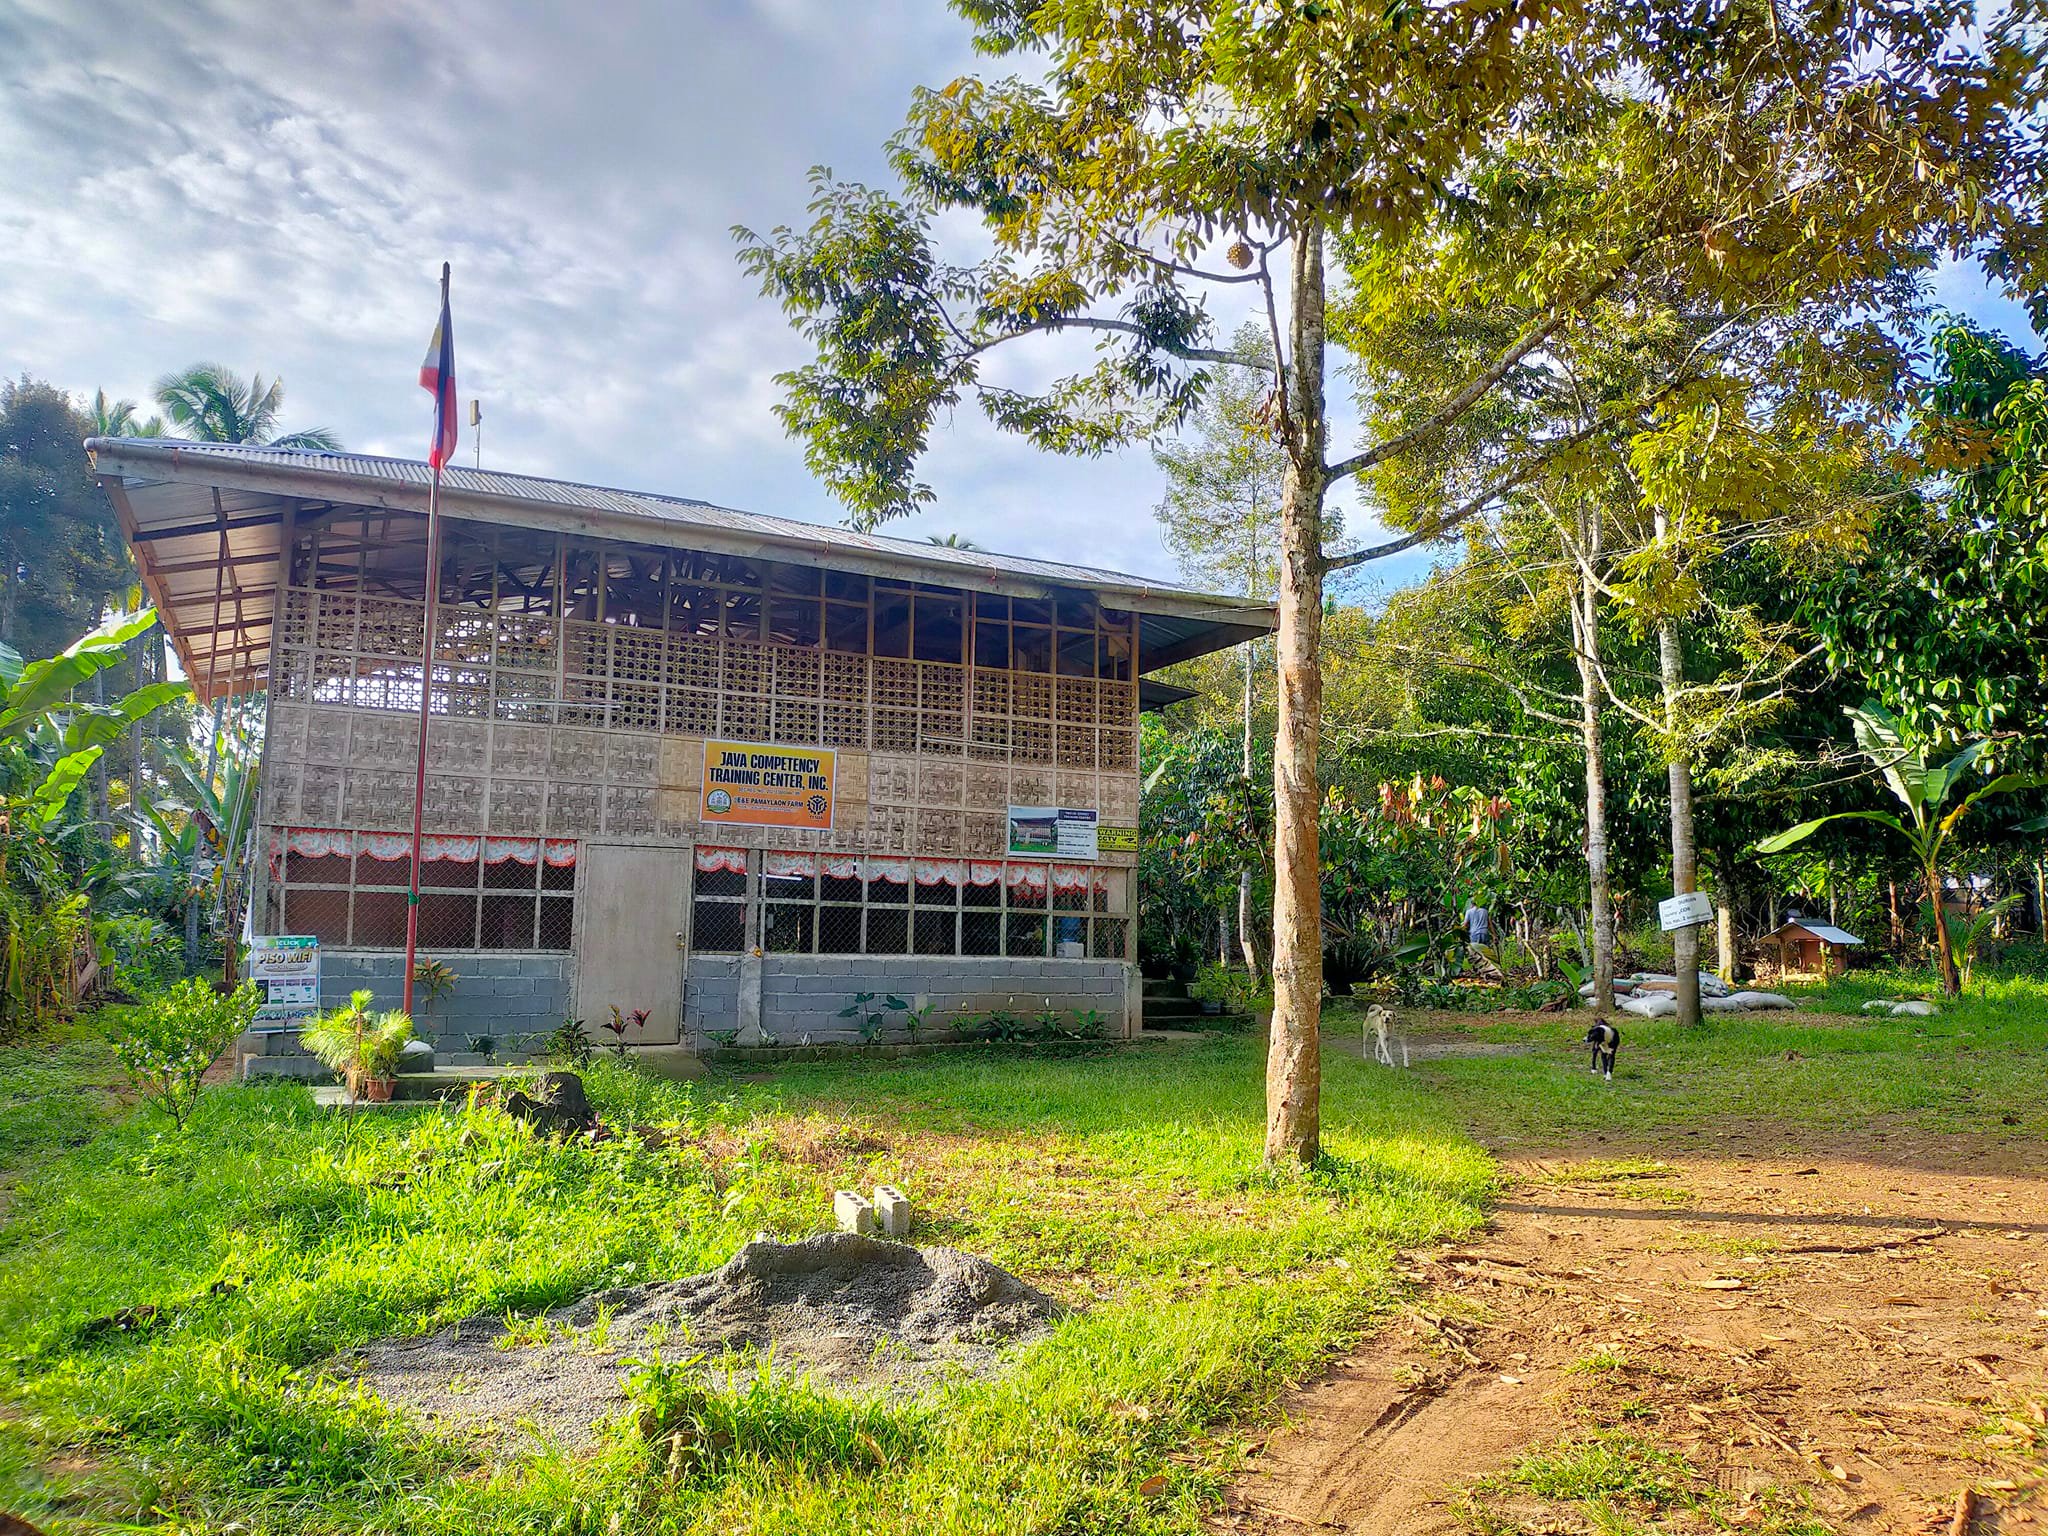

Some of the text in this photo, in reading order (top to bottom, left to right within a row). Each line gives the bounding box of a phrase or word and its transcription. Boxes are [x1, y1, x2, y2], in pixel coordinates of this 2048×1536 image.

[720, 751, 820, 774] JAVA COMPETENCY
[709, 767, 829, 791] TRAINING CENTER, INC.
[787, 800, 804, 808] FARM
[1098, 828, 1137, 837] WARNING
[259, 952, 312, 964] PISO WIFI
